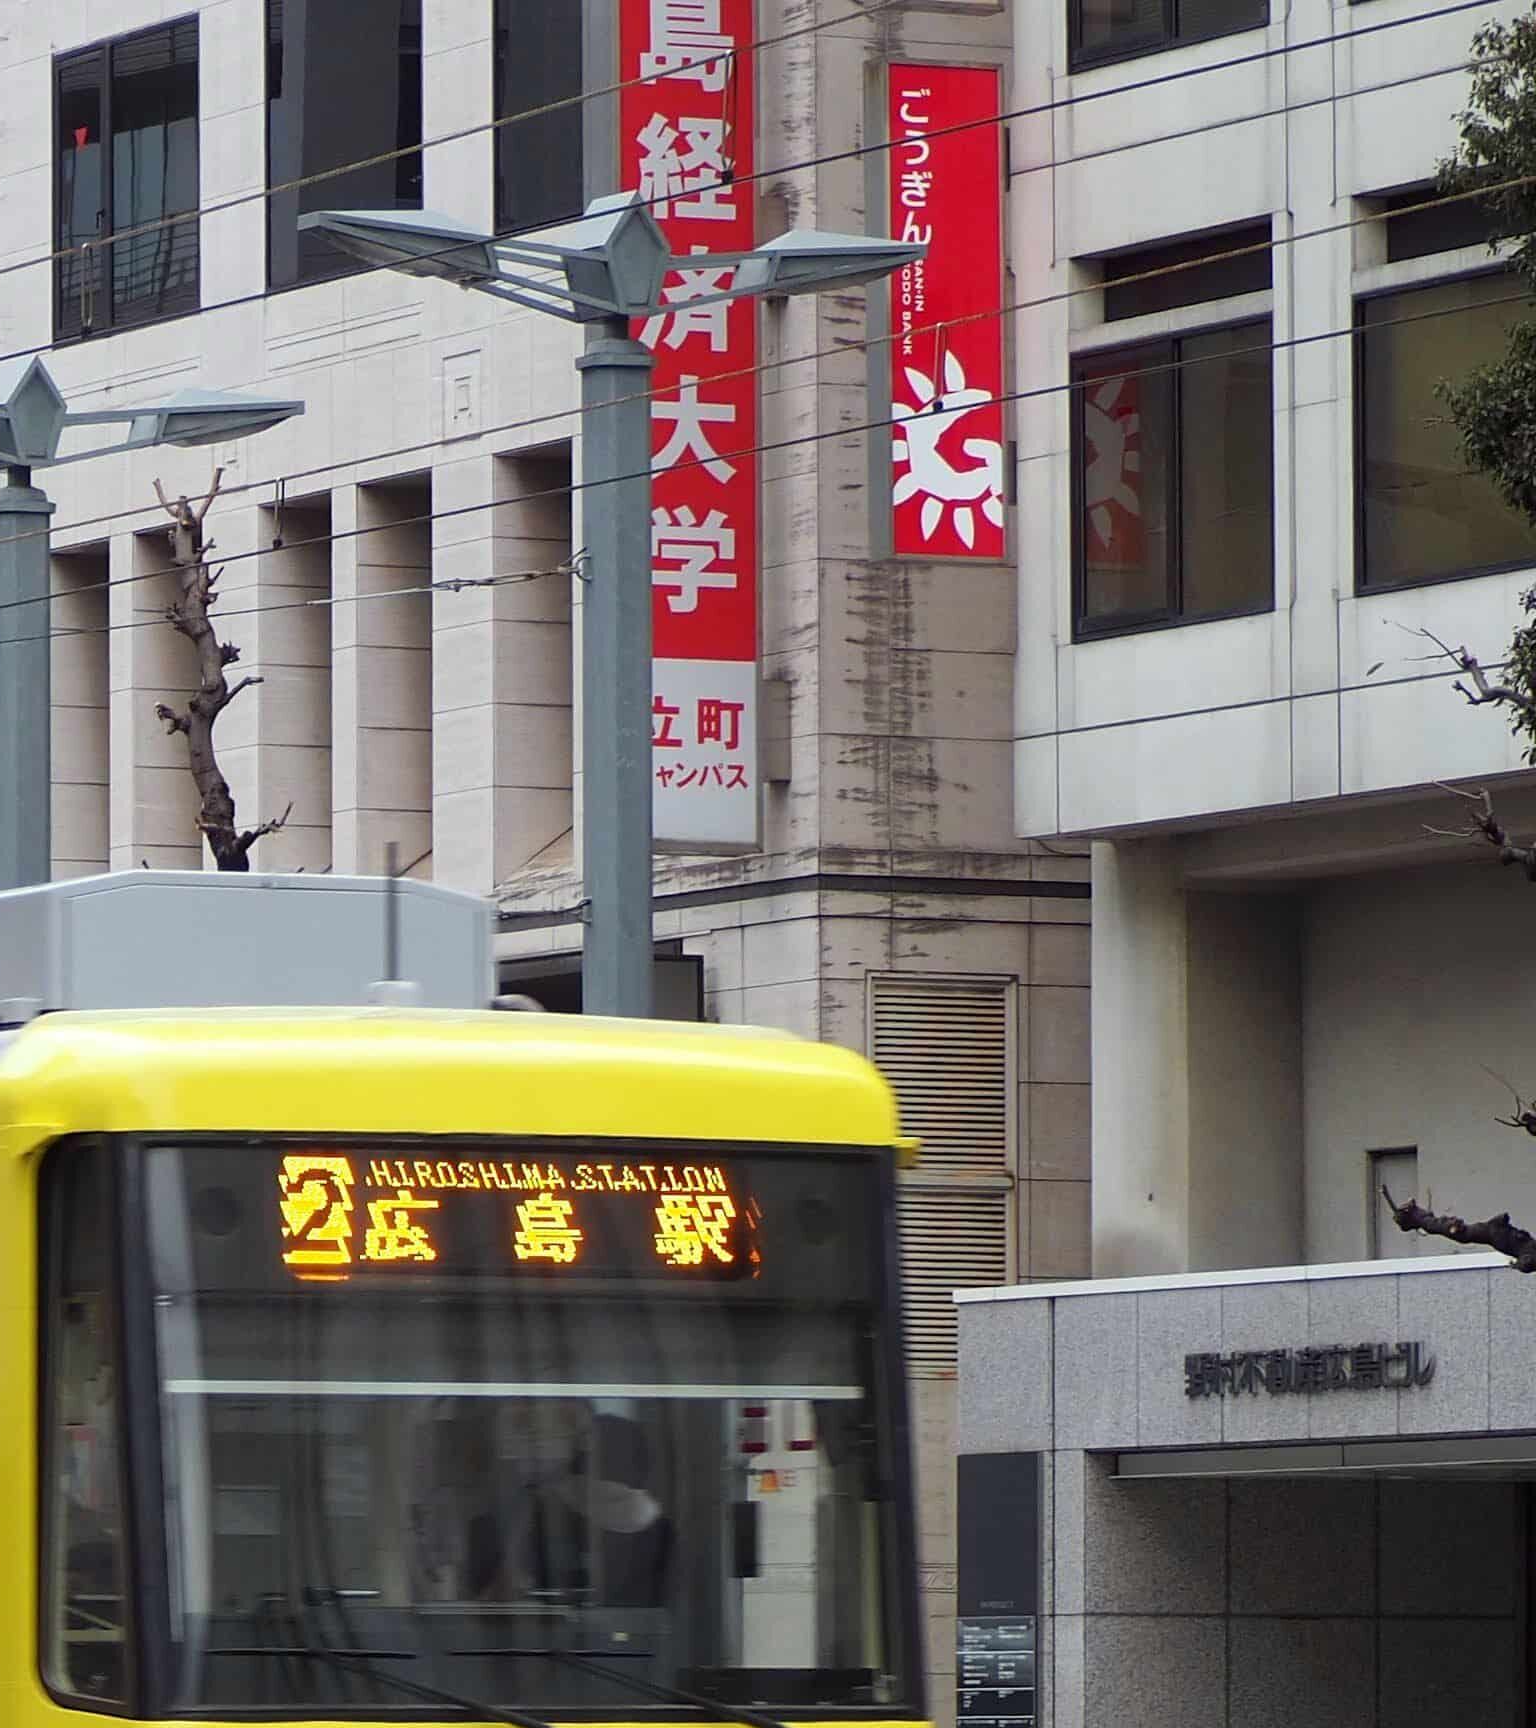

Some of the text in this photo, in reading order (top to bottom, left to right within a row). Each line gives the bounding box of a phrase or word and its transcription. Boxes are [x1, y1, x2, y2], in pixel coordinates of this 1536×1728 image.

[652, 695, 745, 751] 立町
[365, 1159, 727, 1192] HIROSHIMA STATION
